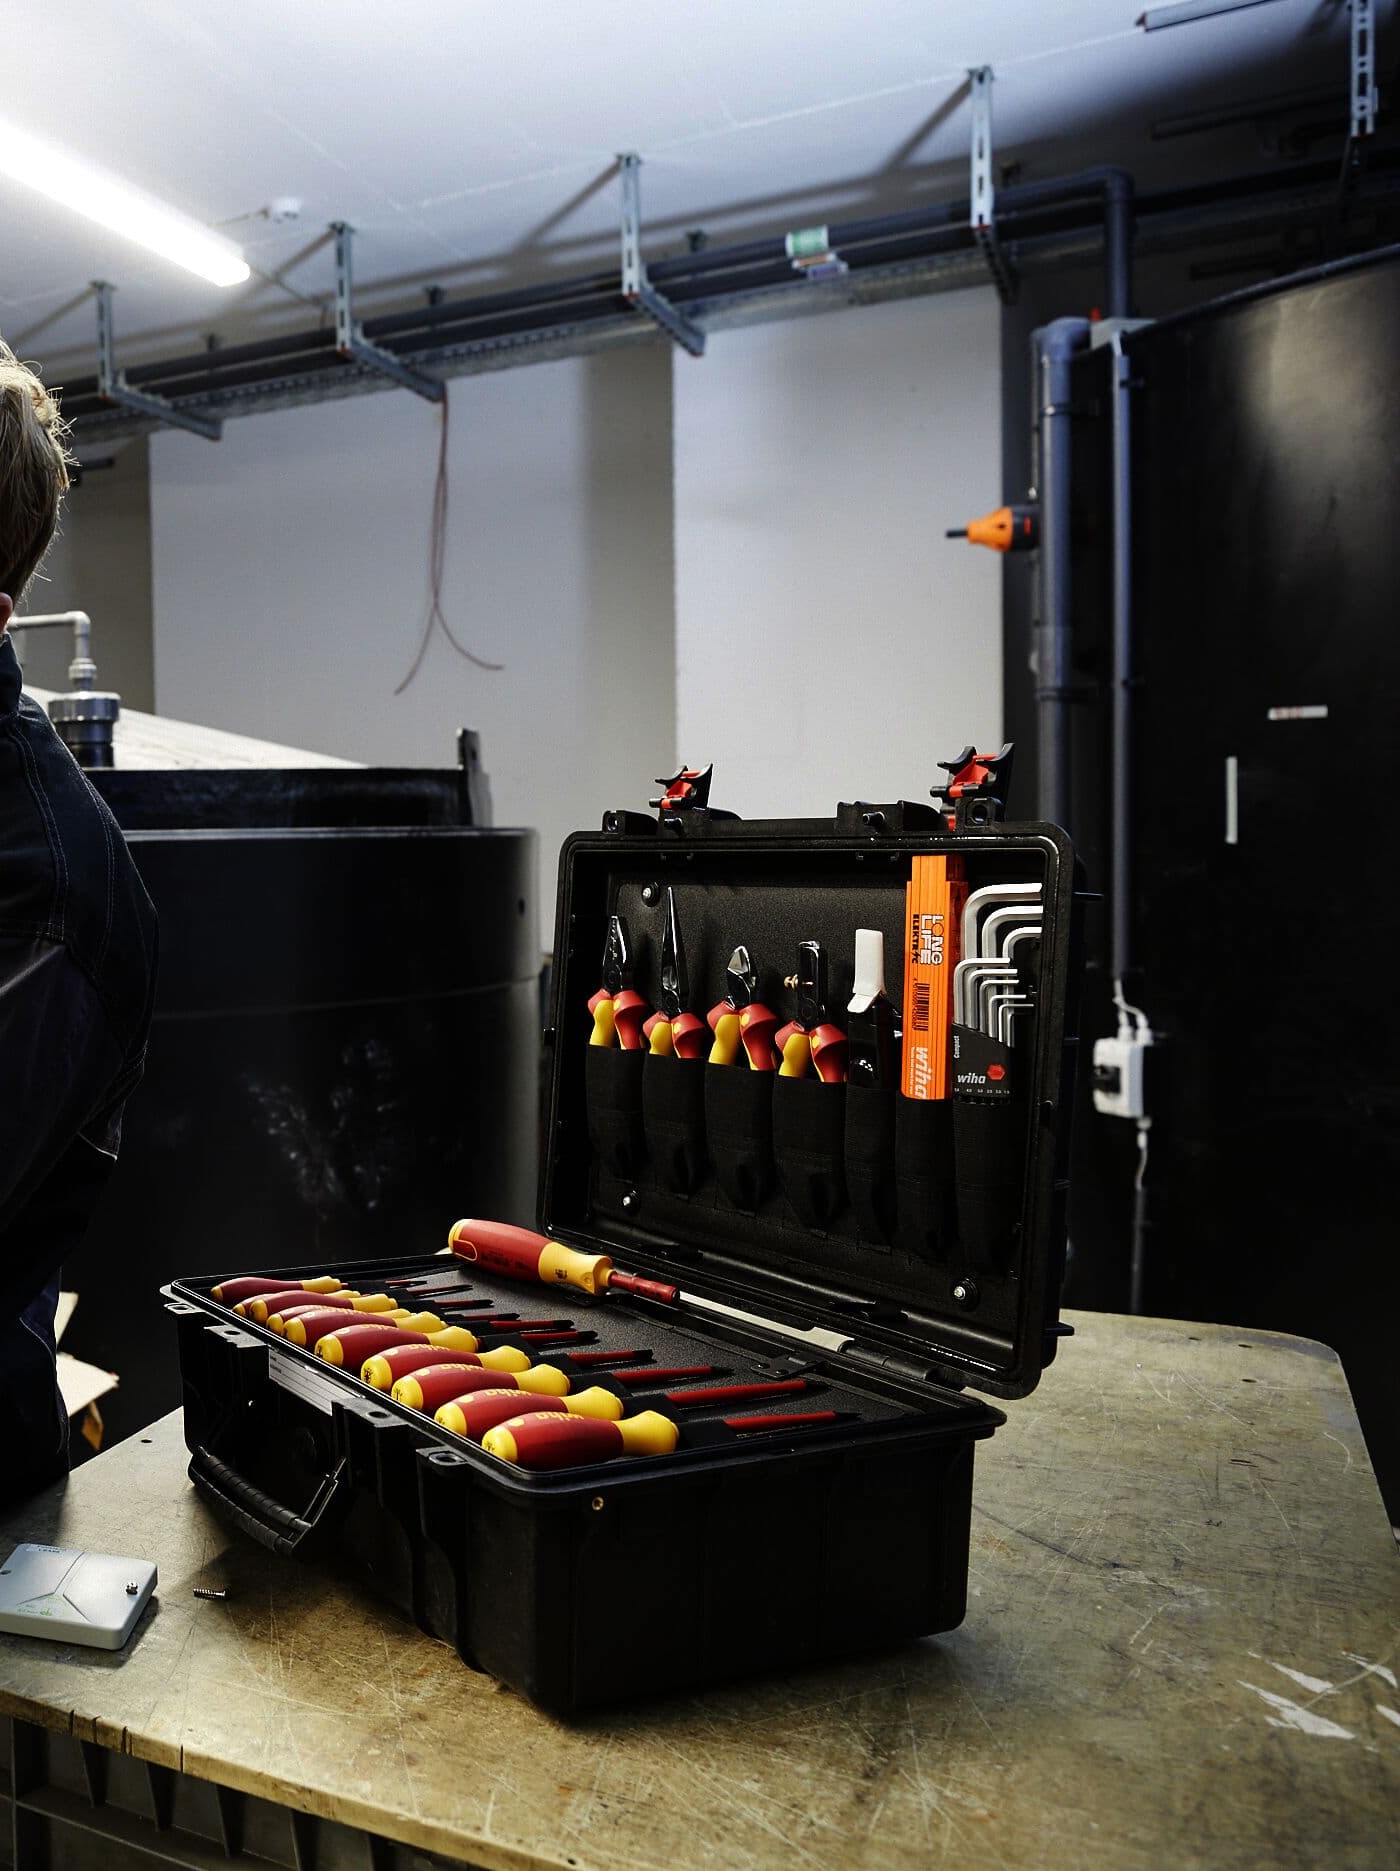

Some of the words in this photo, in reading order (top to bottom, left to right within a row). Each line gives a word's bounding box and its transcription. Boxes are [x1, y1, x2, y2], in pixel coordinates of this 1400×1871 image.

[920, 914, 932, 965] LIFE
[931, 914, 944, 965] LONG
[915, 1047, 933, 1098] wiha
[957, 1072, 986, 1084] wiha
[485, 1388, 532, 1397] wiha
[535, 1411, 584, 1421] wiha
